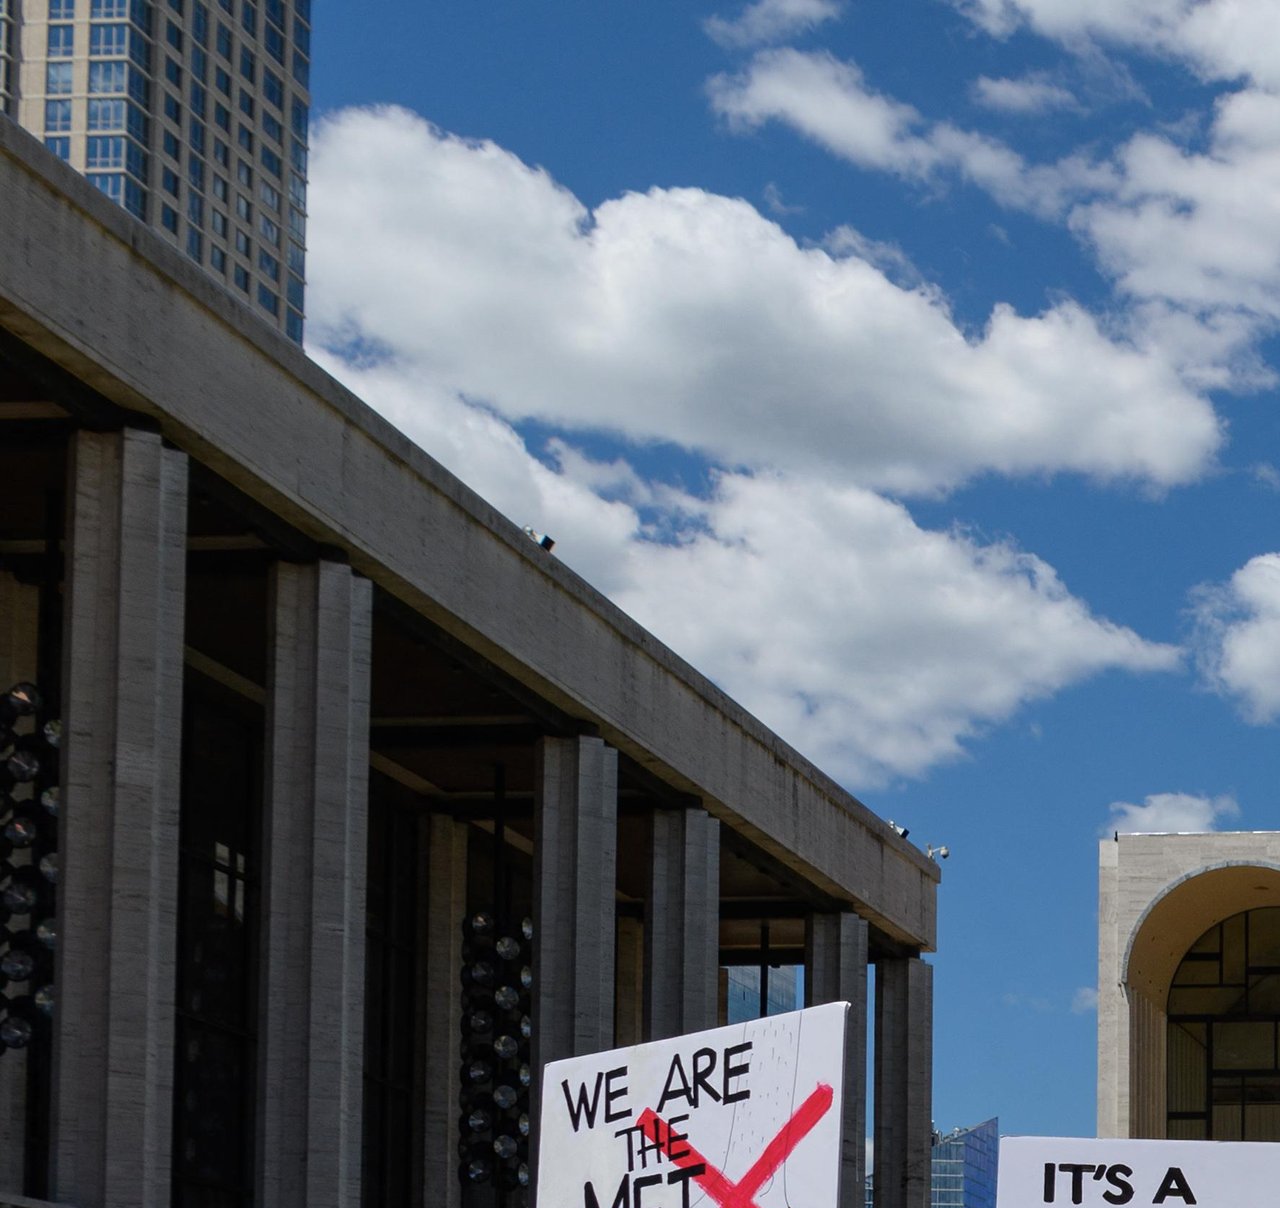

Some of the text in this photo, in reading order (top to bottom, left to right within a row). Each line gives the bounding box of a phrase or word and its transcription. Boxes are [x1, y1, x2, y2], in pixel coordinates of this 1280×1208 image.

[561, 1041, 752, 1132] WE ARE
[615, 1114, 691, 1172] THE
[1043, 1162, 1197, 1205] IT'S A
